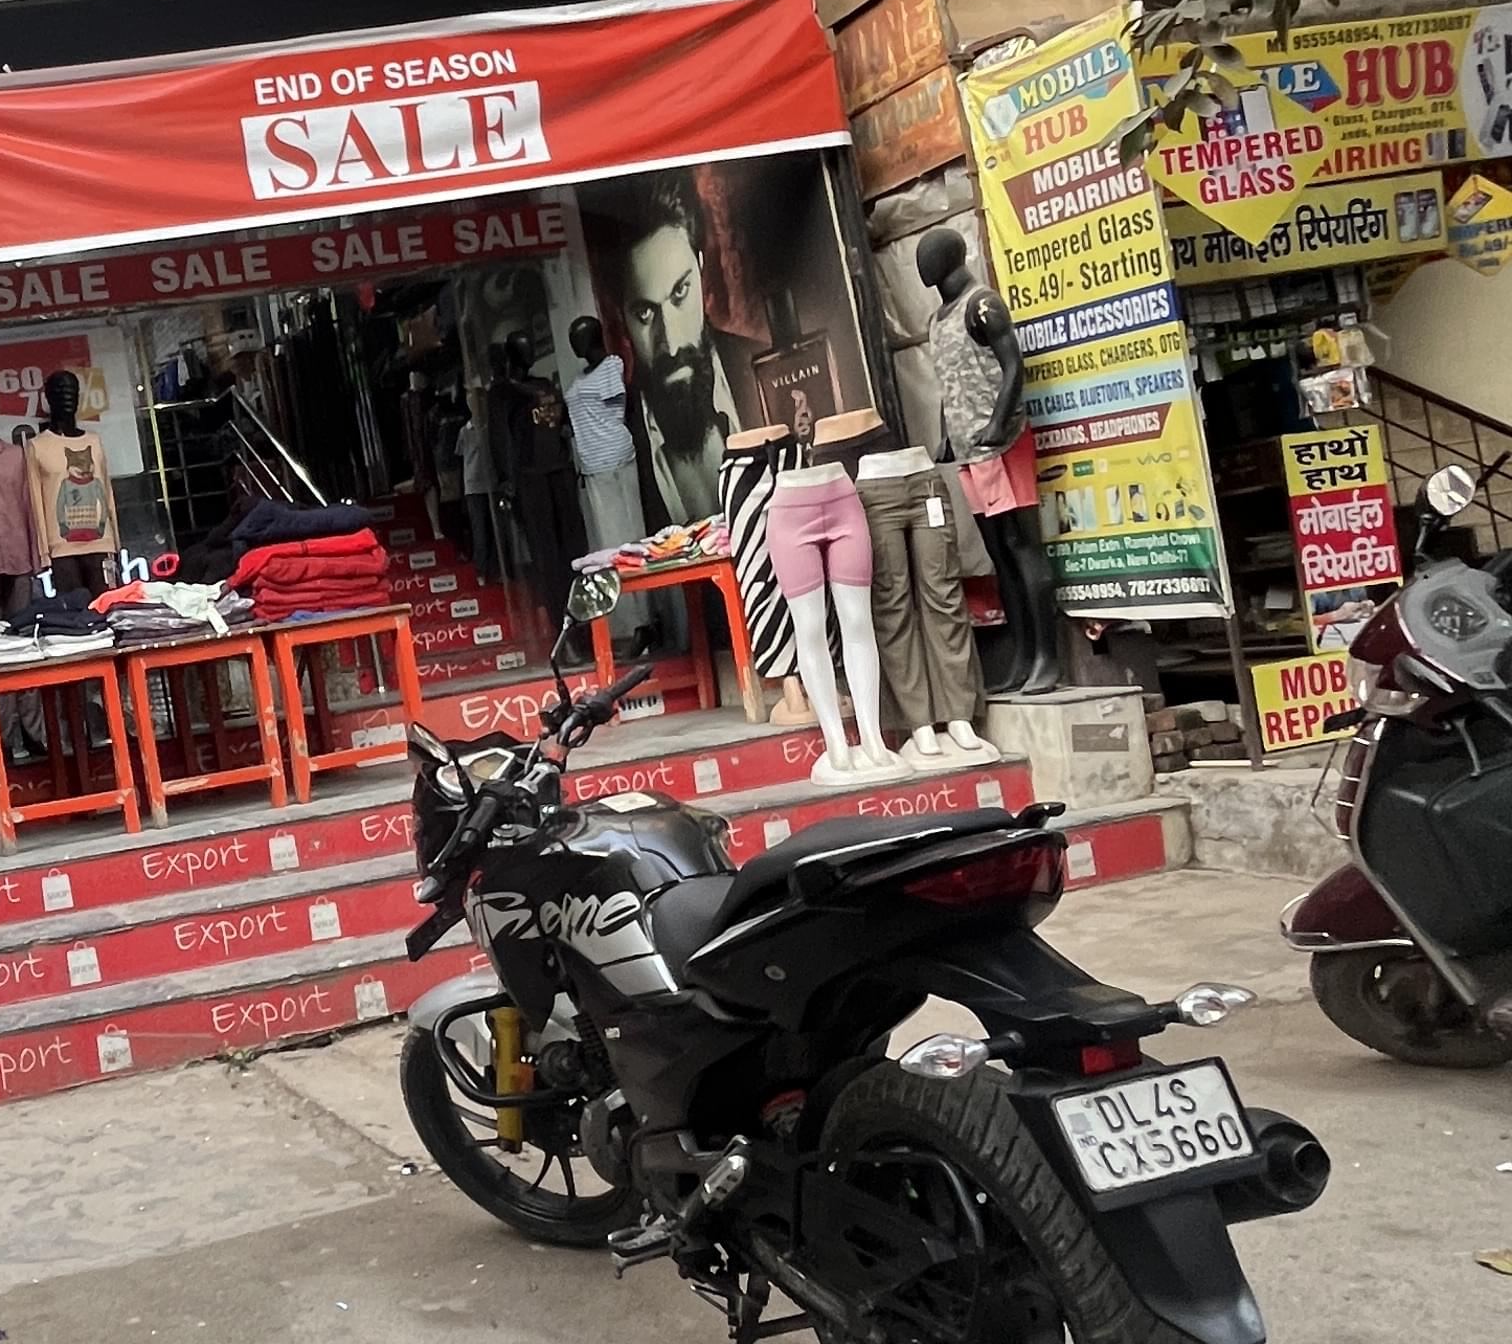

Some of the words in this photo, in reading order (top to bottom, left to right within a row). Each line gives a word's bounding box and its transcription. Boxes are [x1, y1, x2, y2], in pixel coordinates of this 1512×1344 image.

[252, 70, 323, 106] END
[330, 65, 376, 96] OF
[381, 48, 516, 92] SEASON
[1017, 40, 1123, 113] MOBILE
[1343, 39, 1457, 109] HUB
[263, 86, 529, 195] SALE
[1021, 103, 1089, 155] HUB
[1158, 123, 1325, 178] TEMPERED
[1031, 140, 1122, 195] MOBILE
[1197, 163, 1297, 205] GLASS
[1023, 165, 1145, 233] REPAIRING
[150, 246, 272, 294] SALE
[311, 225, 428, 272] SALE
[453, 206, 567, 254] SALE
[1003, 222, 1093, 276] Tempered
[1098, 207, 1155, 244] Glass
[1007, 269, 1075, 312] Rs.49/-
[1079, 246, 1163, 298] Starting
[1014, 318, 1067, 354] MOBILE
[1069, 287, 1171, 340] ACCESSORIES
[1159, 331, 1182, 353] OTG
[770, 362, 821, 390] VILLAIN
[1137, 368, 1185, 396] SPEAKERS
[1089, 411, 1161, 442] HEADPHONES
[1289, 429, 1370, 466] हाथों
[1300, 461, 1369, 491] हाथ
[1279, 659, 1348, 701] MOB
[142, 837, 250, 886] Export
[173, 905, 289, 956] Export
[211, 985, 332, 1039] Export
[1098, 1112, 1243, 1179] CX5660
